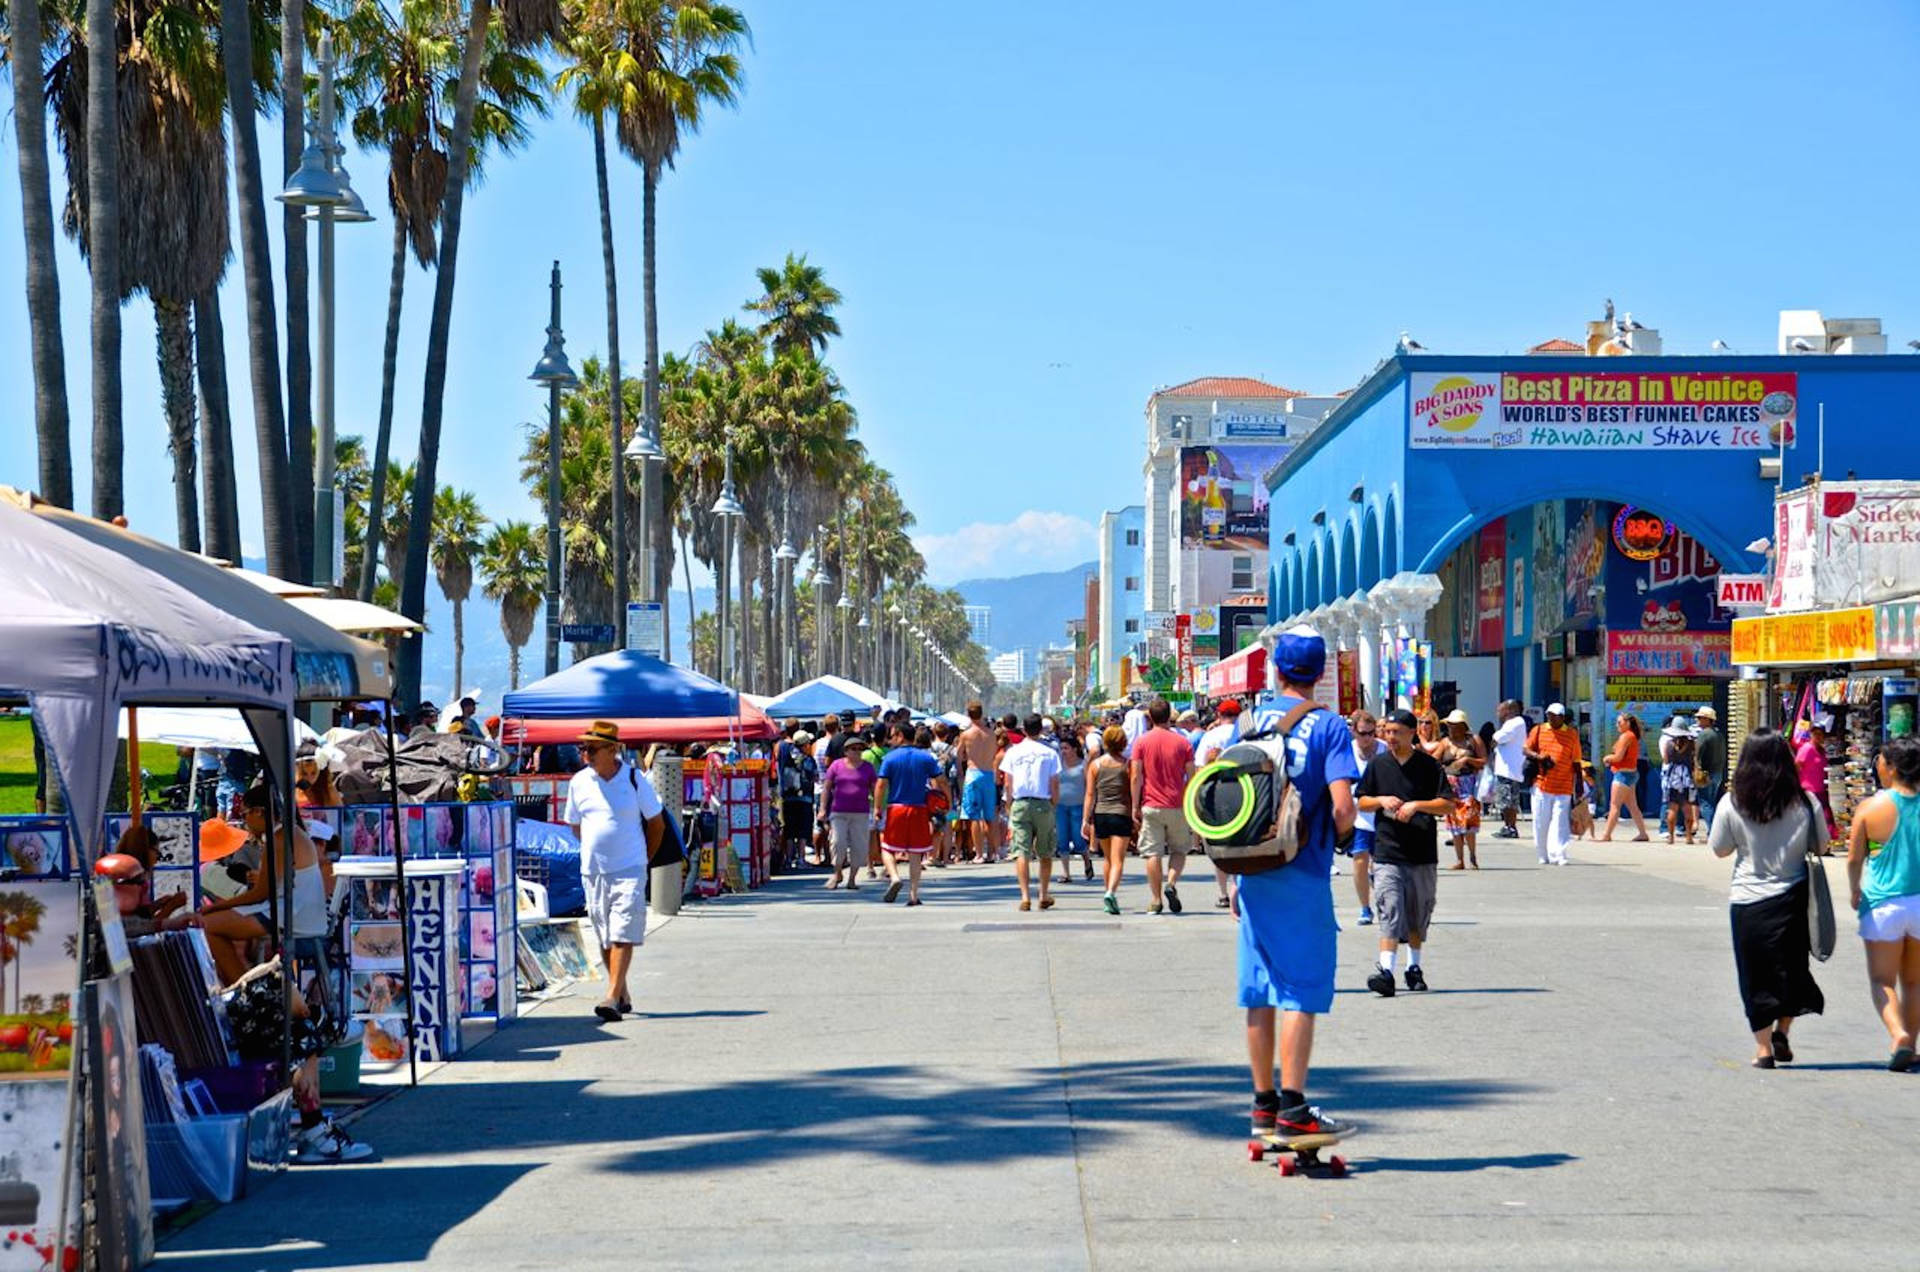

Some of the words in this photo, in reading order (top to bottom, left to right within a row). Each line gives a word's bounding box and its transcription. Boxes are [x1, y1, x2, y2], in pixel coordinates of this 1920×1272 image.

[1415, 395, 1441, 417] BIG
[1443, 384, 1496, 405] DADDY
[1502, 376, 1563, 402] Best
[1568, 376, 1632, 402] Pizza
[1639, 376, 1664, 402] in
[1670, 376, 1764, 402] Venice
[1427, 412, 1440, 427] &
[1442, 402, 1484, 422] SONS
[1504, 406, 1582, 423] WORLD'S
[1587, 406, 1630, 423] BEST
[1635, 406, 1698, 423] FUNNEL
[1703, 406, 1761, 423] CAKES
[1493, 429, 1523, 448] Real
[1721, 583, 1764, 602] ATM
[1612, 649, 1686, 670] FUNNEL
[412, 879, 441, 1062] HENNA
